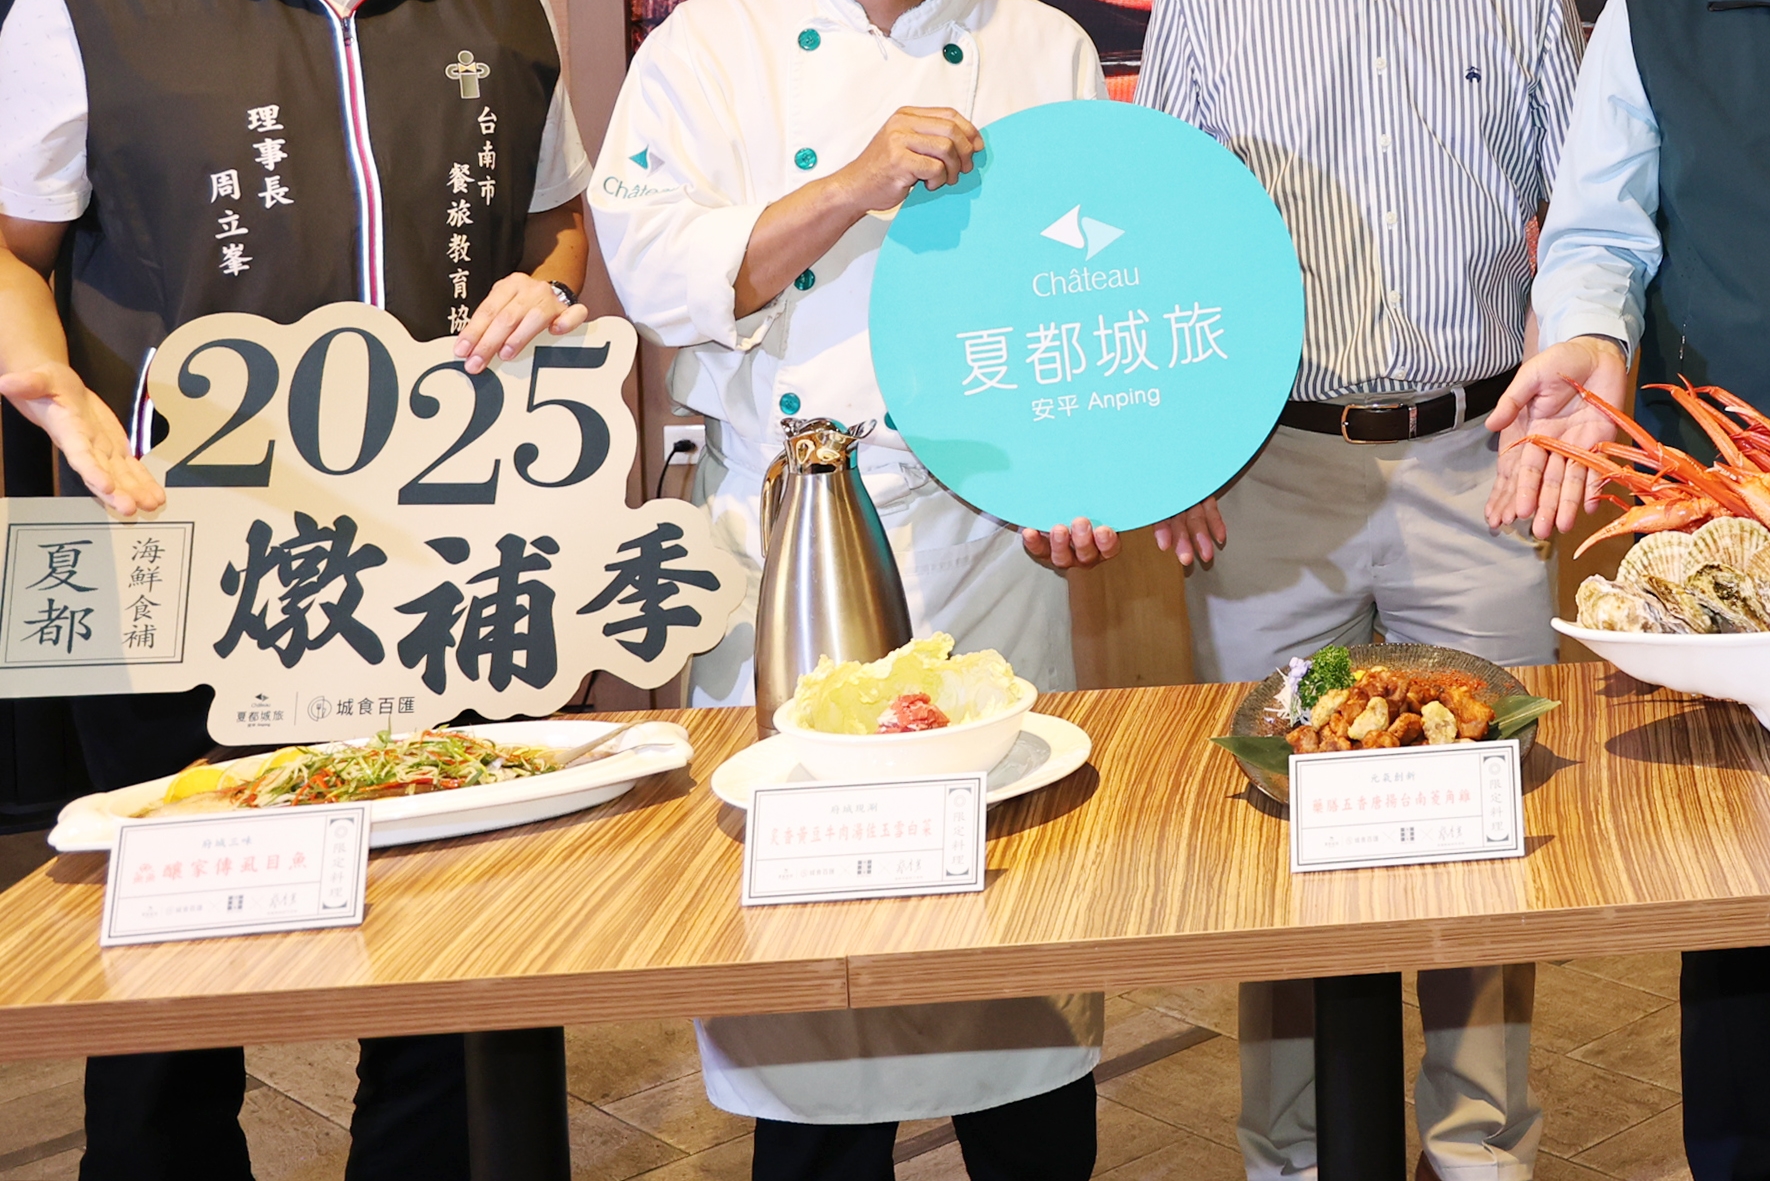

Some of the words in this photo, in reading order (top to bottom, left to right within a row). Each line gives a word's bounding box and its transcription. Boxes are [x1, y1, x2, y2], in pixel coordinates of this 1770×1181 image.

[247, 104, 294, 209] 理事長
[477, 106, 498, 206] 台南市
[603, 176, 679, 199] Châte
[1031, 263, 1140, 299] Château
[956, 302, 1229, 396] 夏都城旅
[164, 327, 611, 505] 2025
[1031, 396, 1079, 422] 安平
[1087, 384, 1161, 411] Anping
[21, 538, 98, 655] 夏都
[123, 537, 166, 650] 海鮮食補
[212, 510, 721, 695] 燉補季
[336, 696, 415, 716] 城食百匯
